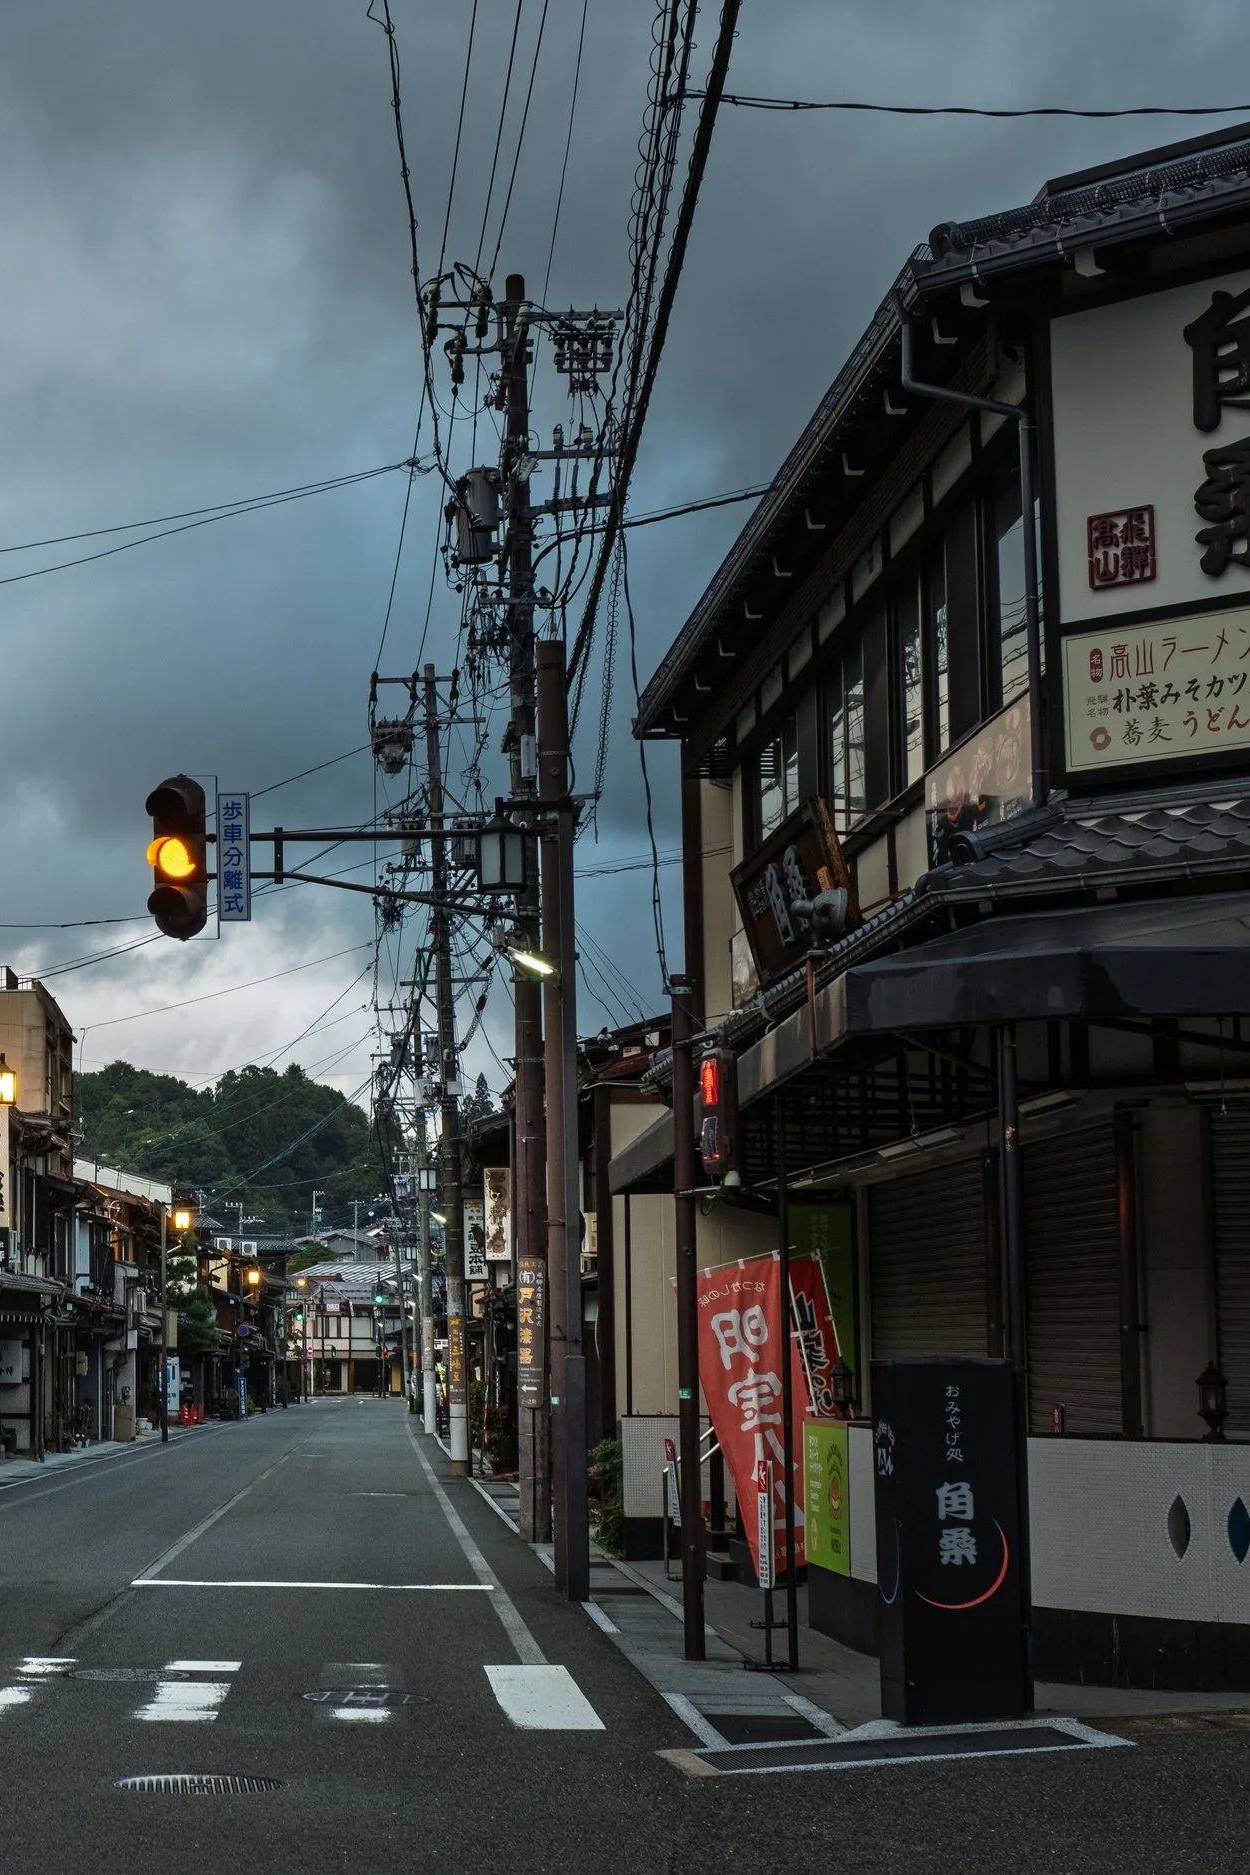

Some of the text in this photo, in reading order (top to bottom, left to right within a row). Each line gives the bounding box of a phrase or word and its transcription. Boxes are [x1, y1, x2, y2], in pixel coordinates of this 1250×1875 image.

[1121, 717, 1173, 751] 蕎麦
[223, 801, 243, 914] 歩車分離式
[945, 1385, 964, 1462] おみやげ処
[936, 1481, 979, 1567] 角桑
